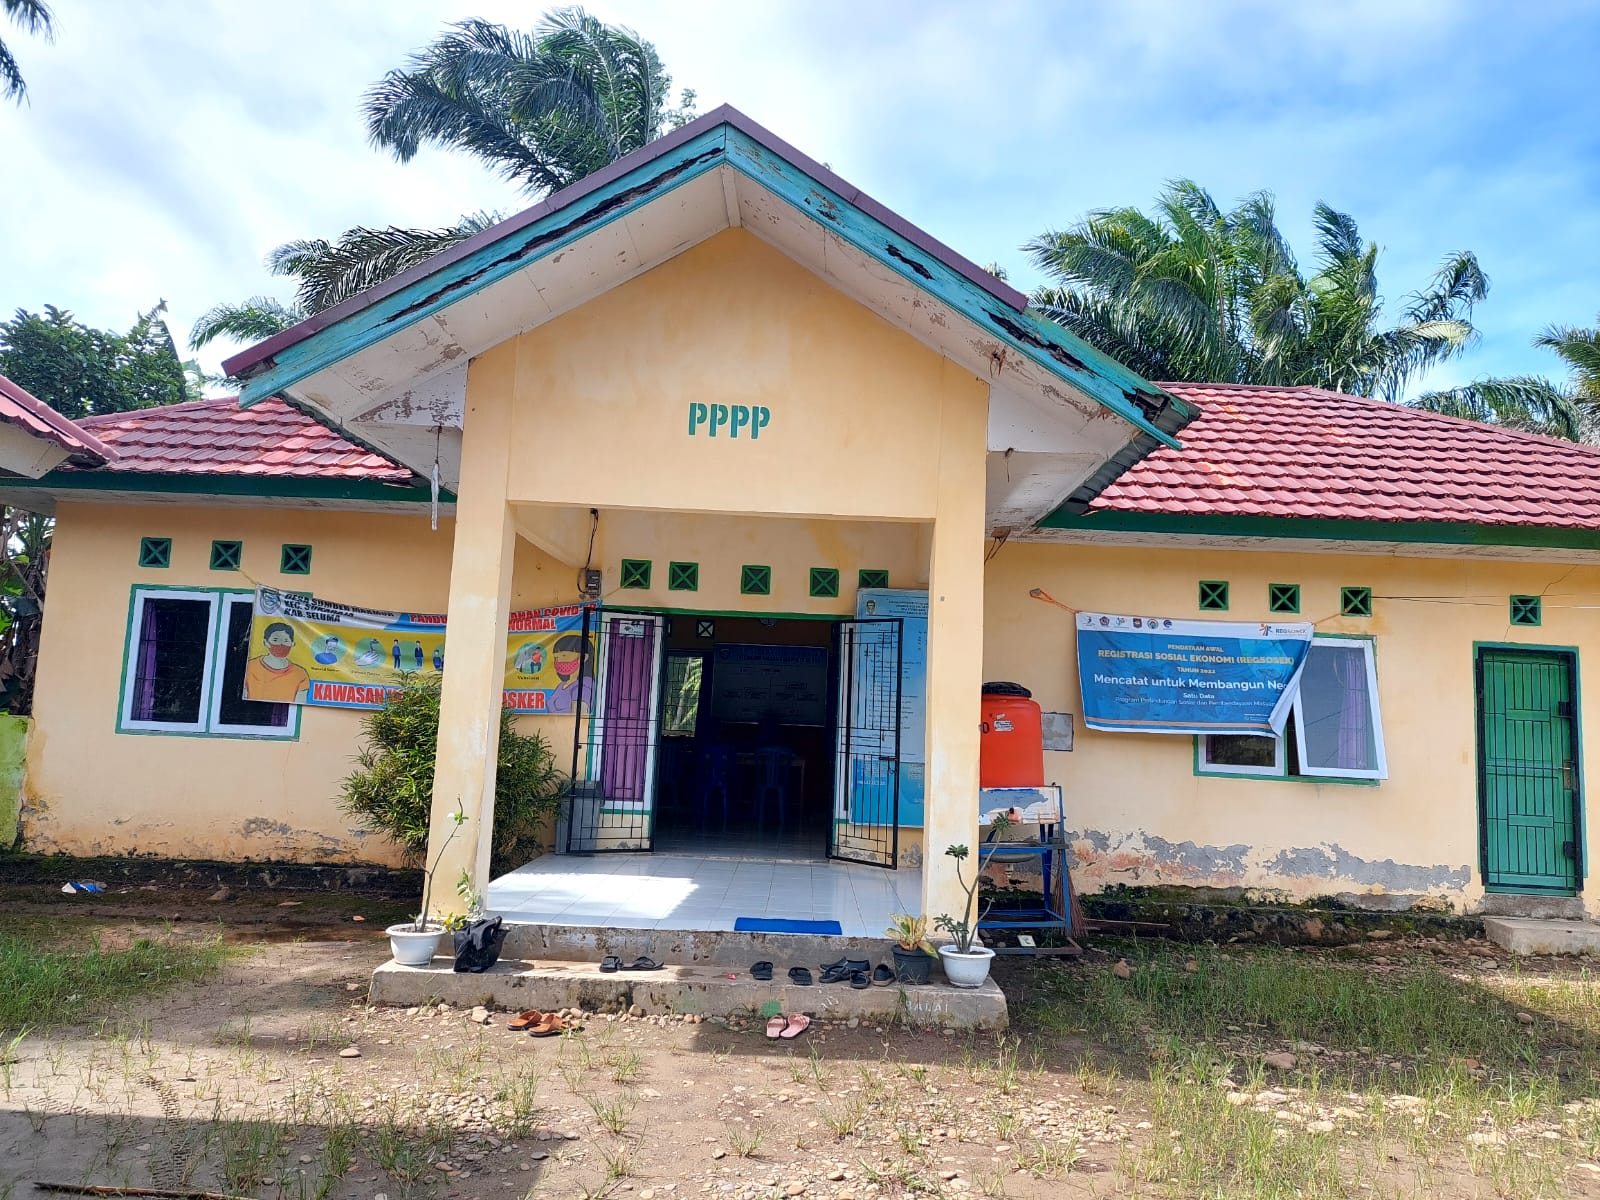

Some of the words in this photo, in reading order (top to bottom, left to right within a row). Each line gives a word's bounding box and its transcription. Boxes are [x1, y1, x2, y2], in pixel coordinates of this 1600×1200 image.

[688, 402, 771, 440] PPPP
[284, 593, 309, 604] DESA
[284, 607, 305, 618] KAB.
[305, 610, 341, 623] SELUMA
[410, 614, 448, 624] PANDU
[509, 609, 541, 620] AHAN
[544, 603, 597, 617] COVID-9
[1098, 649, 1153, 659] REGISTRASI
[1155, 652, 1188, 662] SOSIAL
[1190, 654, 1235, 664] EKONOMI
[1094, 673, 1149, 686] Mencatat
[1151, 677, 1186, 688] untuk
[1188, 678, 1265, 691] Membangun
[313, 683, 385, 704] KAWASAN
